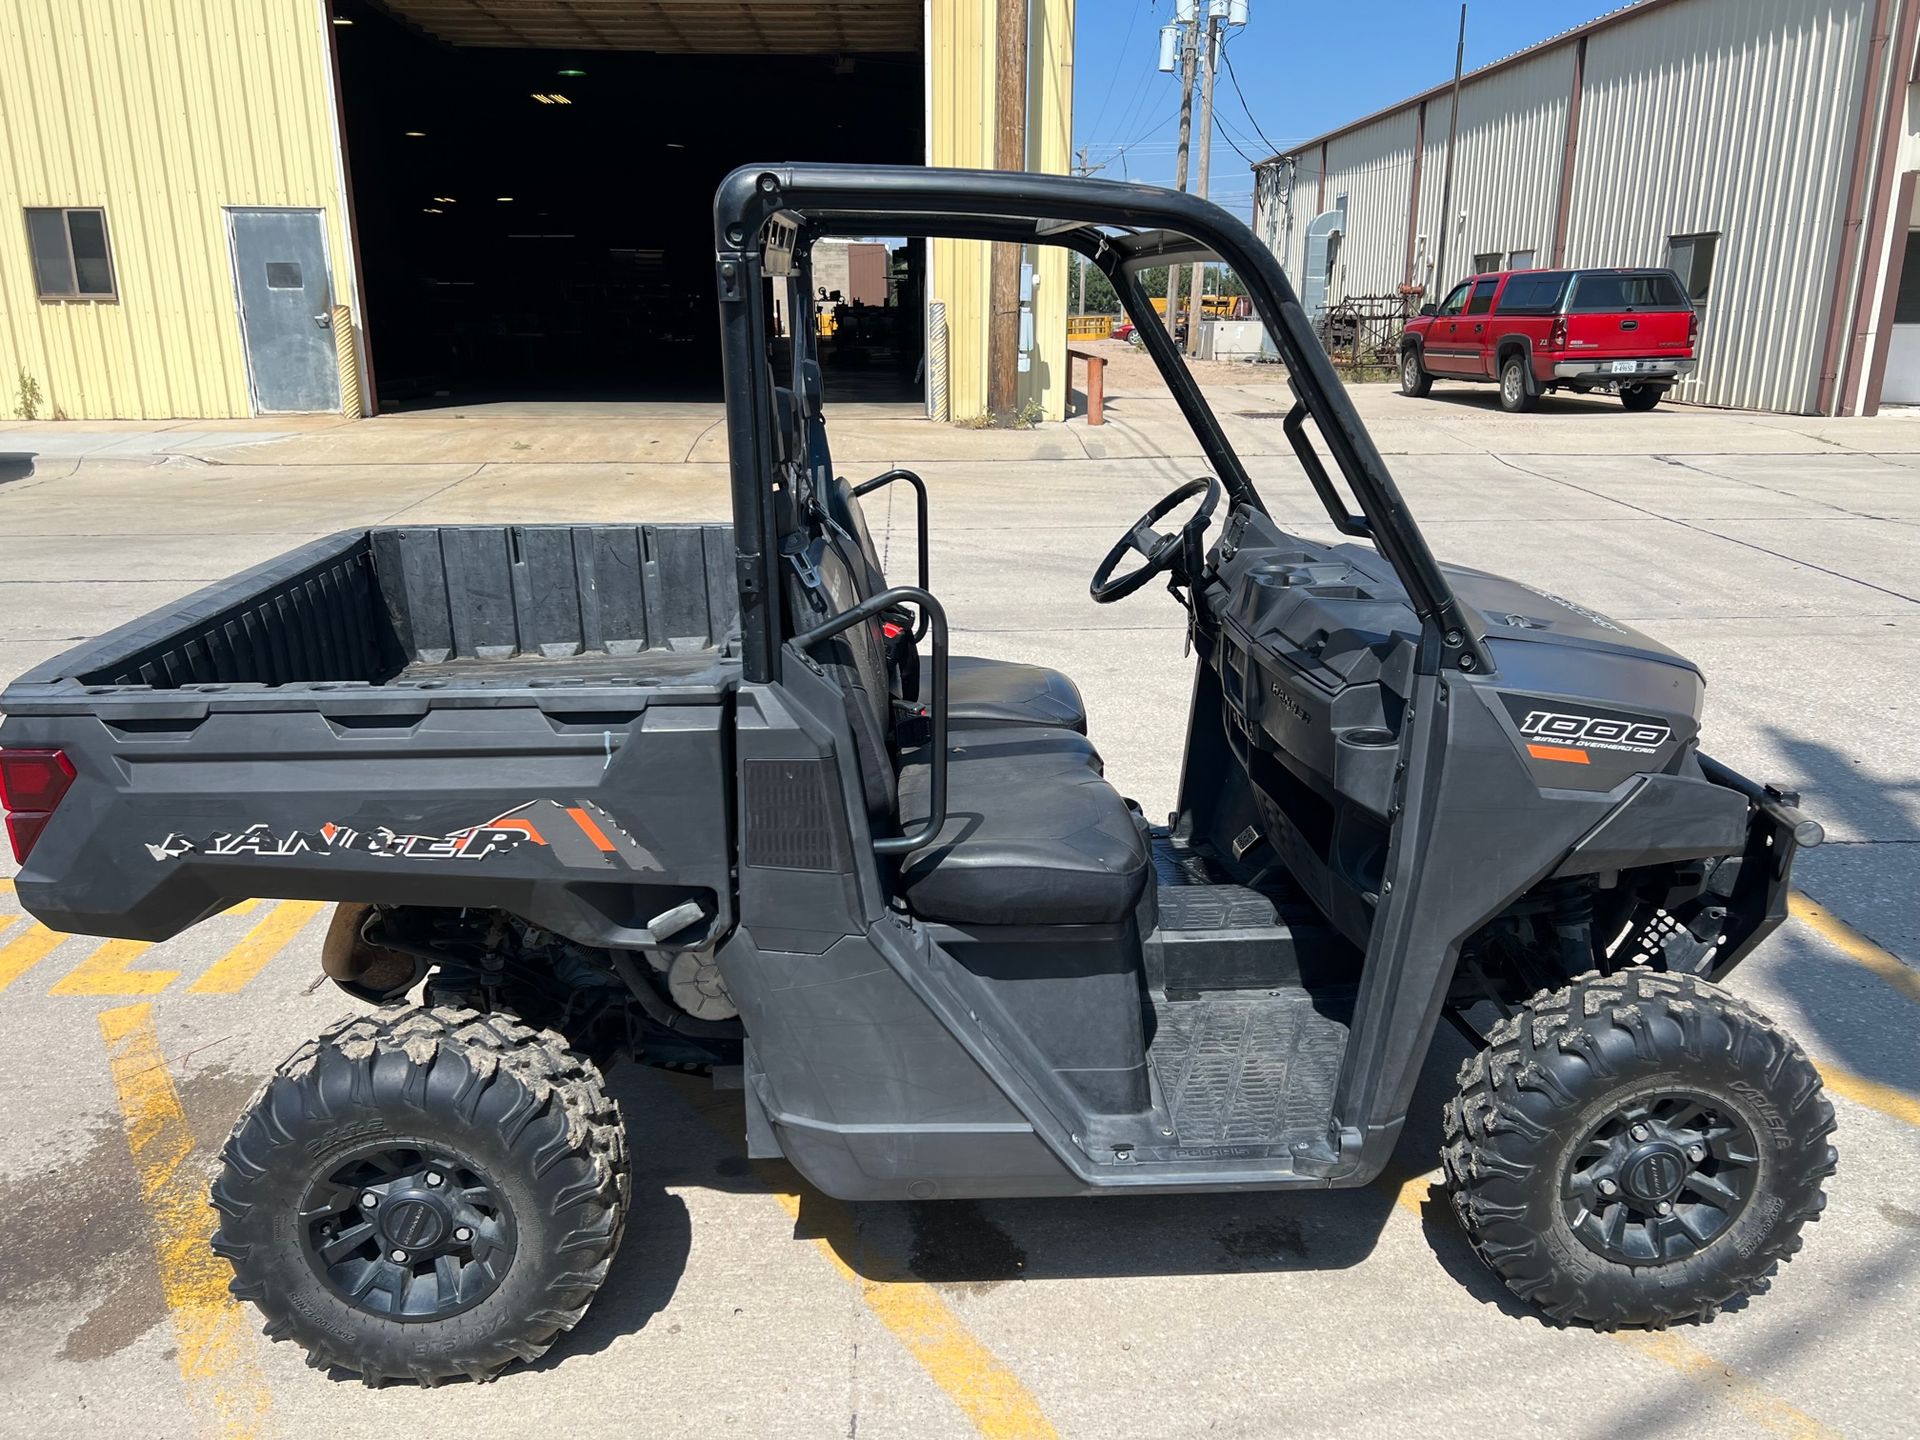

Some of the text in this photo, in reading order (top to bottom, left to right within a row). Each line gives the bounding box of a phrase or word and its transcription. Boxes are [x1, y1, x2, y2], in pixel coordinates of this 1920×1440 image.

[1519, 710, 1671, 747] 1000
[1532, 735, 1575, 746] SINGLE
[1576, 741, 1632, 751] OVERHEAD
[1176, 1148, 1250, 1157] POLARIS
